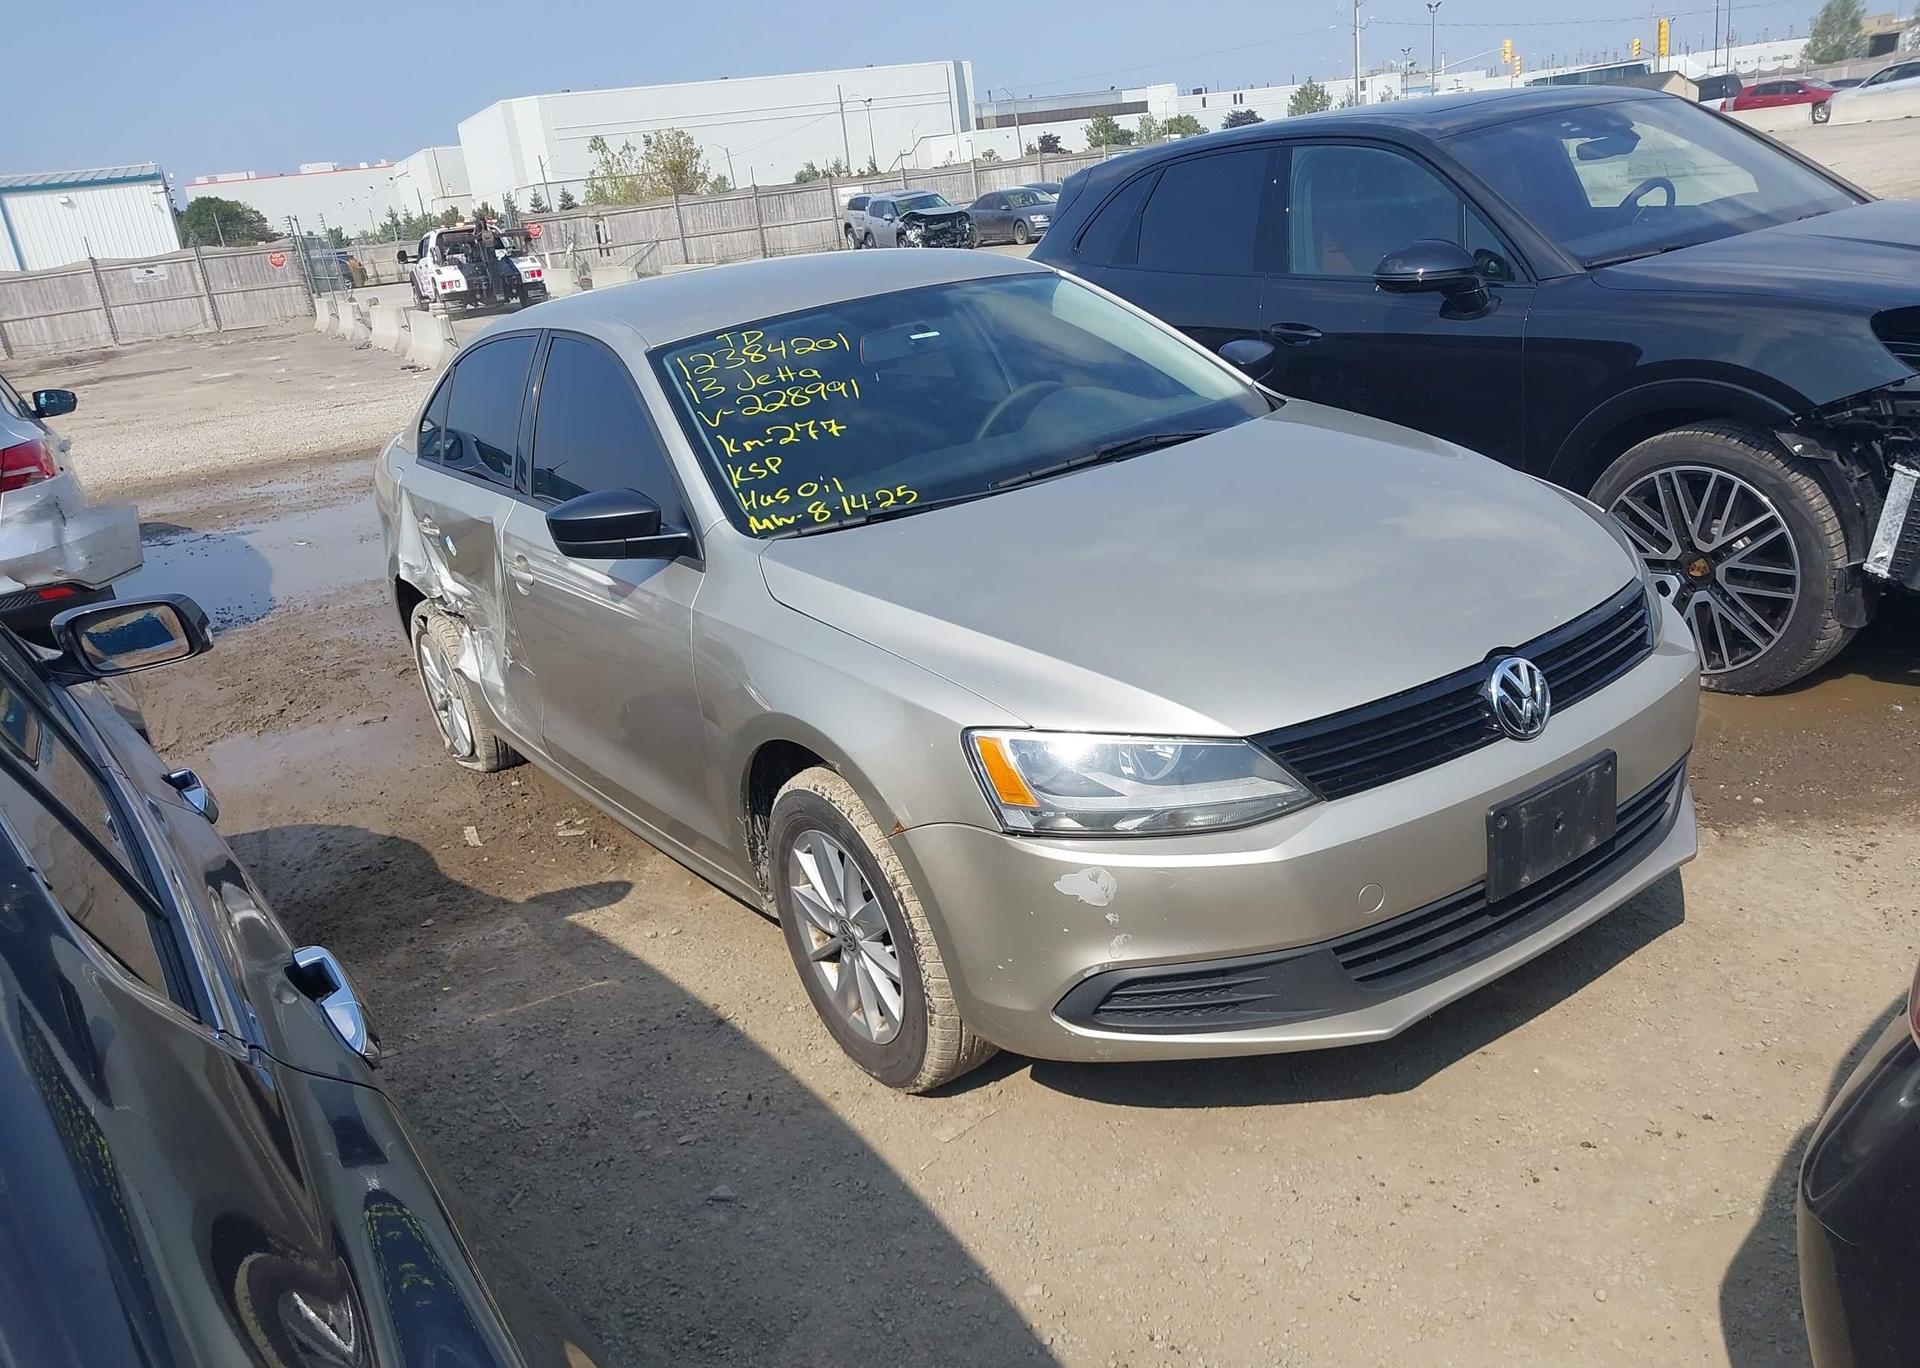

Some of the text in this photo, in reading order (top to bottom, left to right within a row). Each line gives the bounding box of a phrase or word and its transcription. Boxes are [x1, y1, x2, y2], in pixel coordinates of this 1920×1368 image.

[677, 333, 850, 381] 12384201
[686, 366, 822, 404] 13 Jetta
[727, 456, 782, 488] KSP
